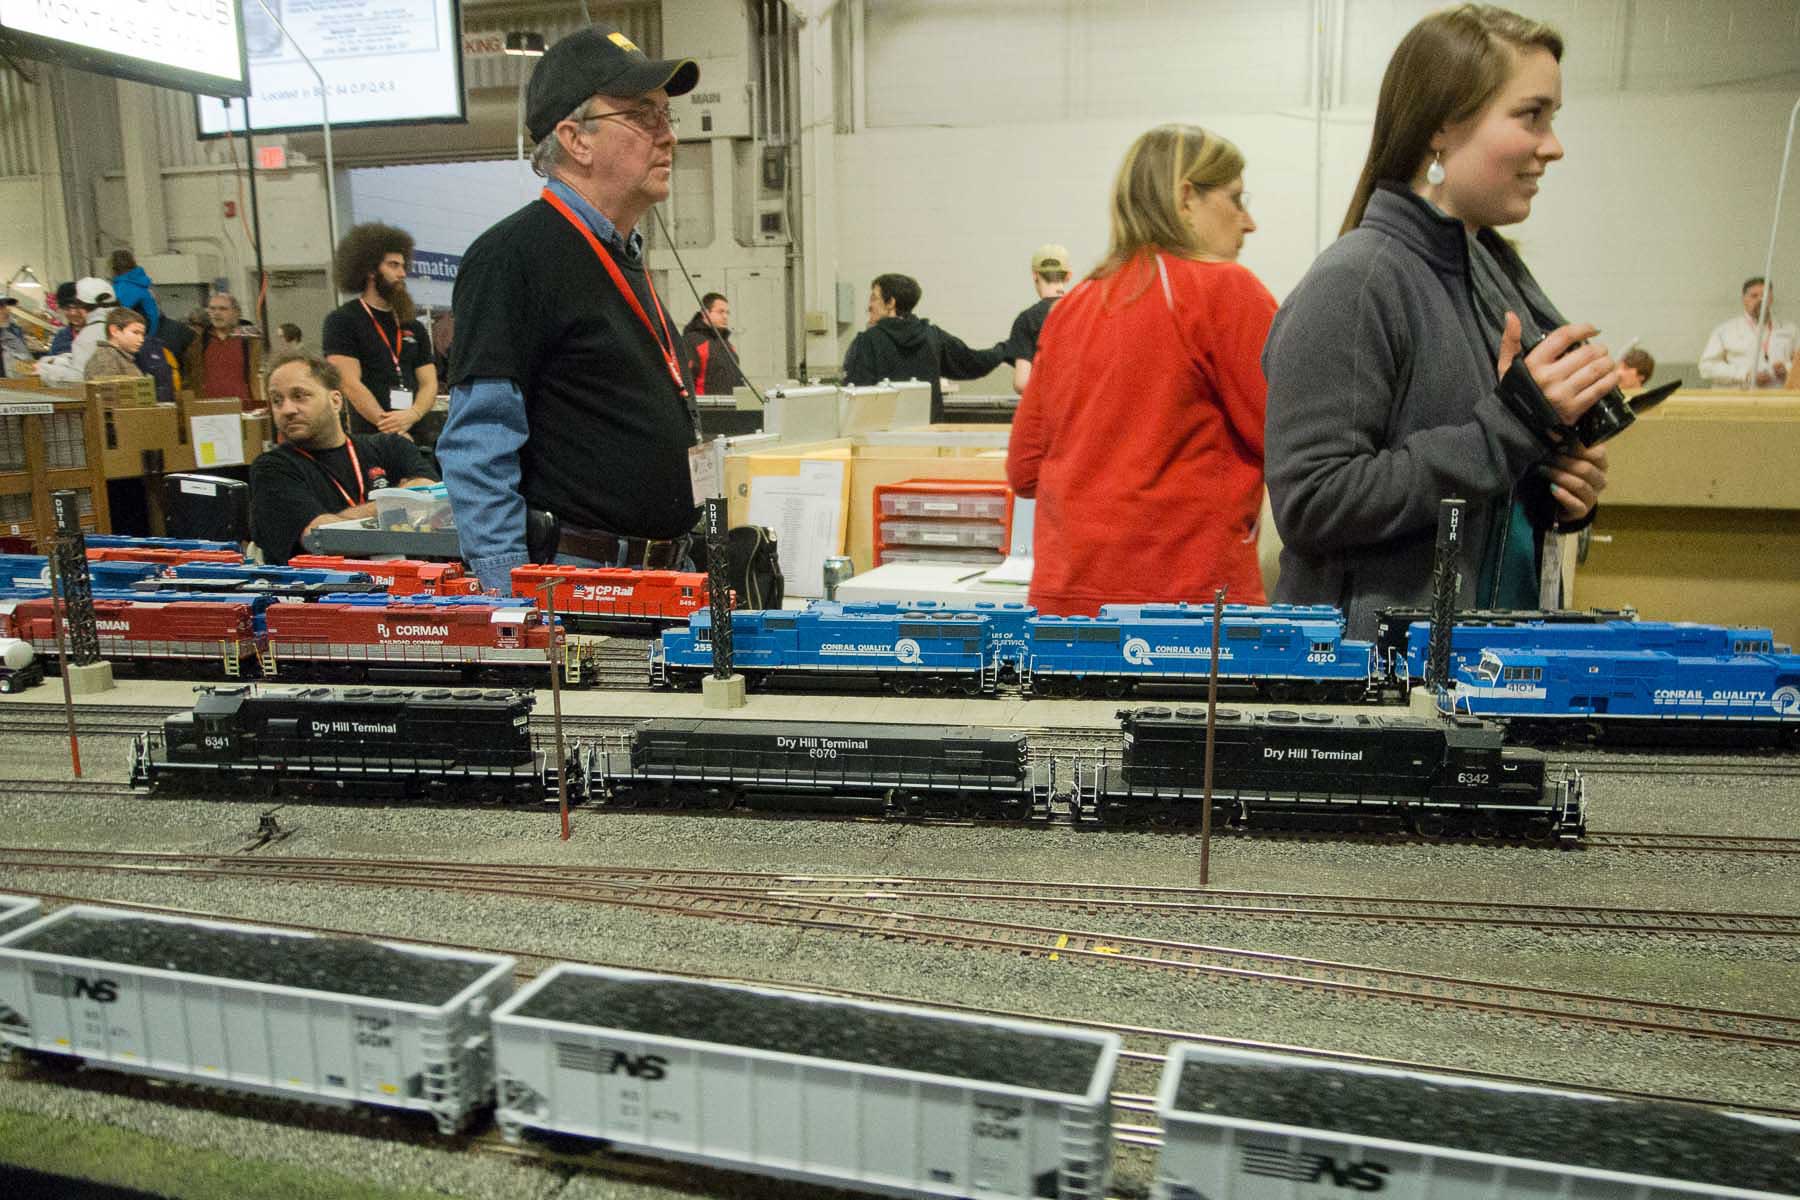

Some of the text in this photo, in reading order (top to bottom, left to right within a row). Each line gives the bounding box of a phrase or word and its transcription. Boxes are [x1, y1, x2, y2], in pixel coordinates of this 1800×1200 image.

[691, 93, 721, 104] MAIN
[55, 498, 65, 529] DHTR
[709, 503, 718, 534] DHTR
[1450, 507, 1459, 541] DHTR
[596, 585, 634, 597] CP Rail
[95, 620, 130, 631] RMAN
[395, 625, 449, 636] CORMAN
[693, 643, 713, 652] 255
[821, 643, 892, 652] CONRAIL QUALITY
[1155, 645, 1191, 654] CONRAIL
[1306, 653, 1336, 664] 6820
[1653, 689, 1766, 700] CONRAIL QUALITY
[312, 720, 397, 735] Dry Hill Terminal
[205, 736, 229, 747] 6341
[777, 736, 869, 749] Dry Hill Terminal
[1264, 748, 1363, 761] Dry Hill Terminal
[1457, 772, 1489, 784] 6342
[74, 976, 118, 1004] NS
[611, 1051, 669, 1081] NS
[1313, 1155, 1393, 1192] NS
